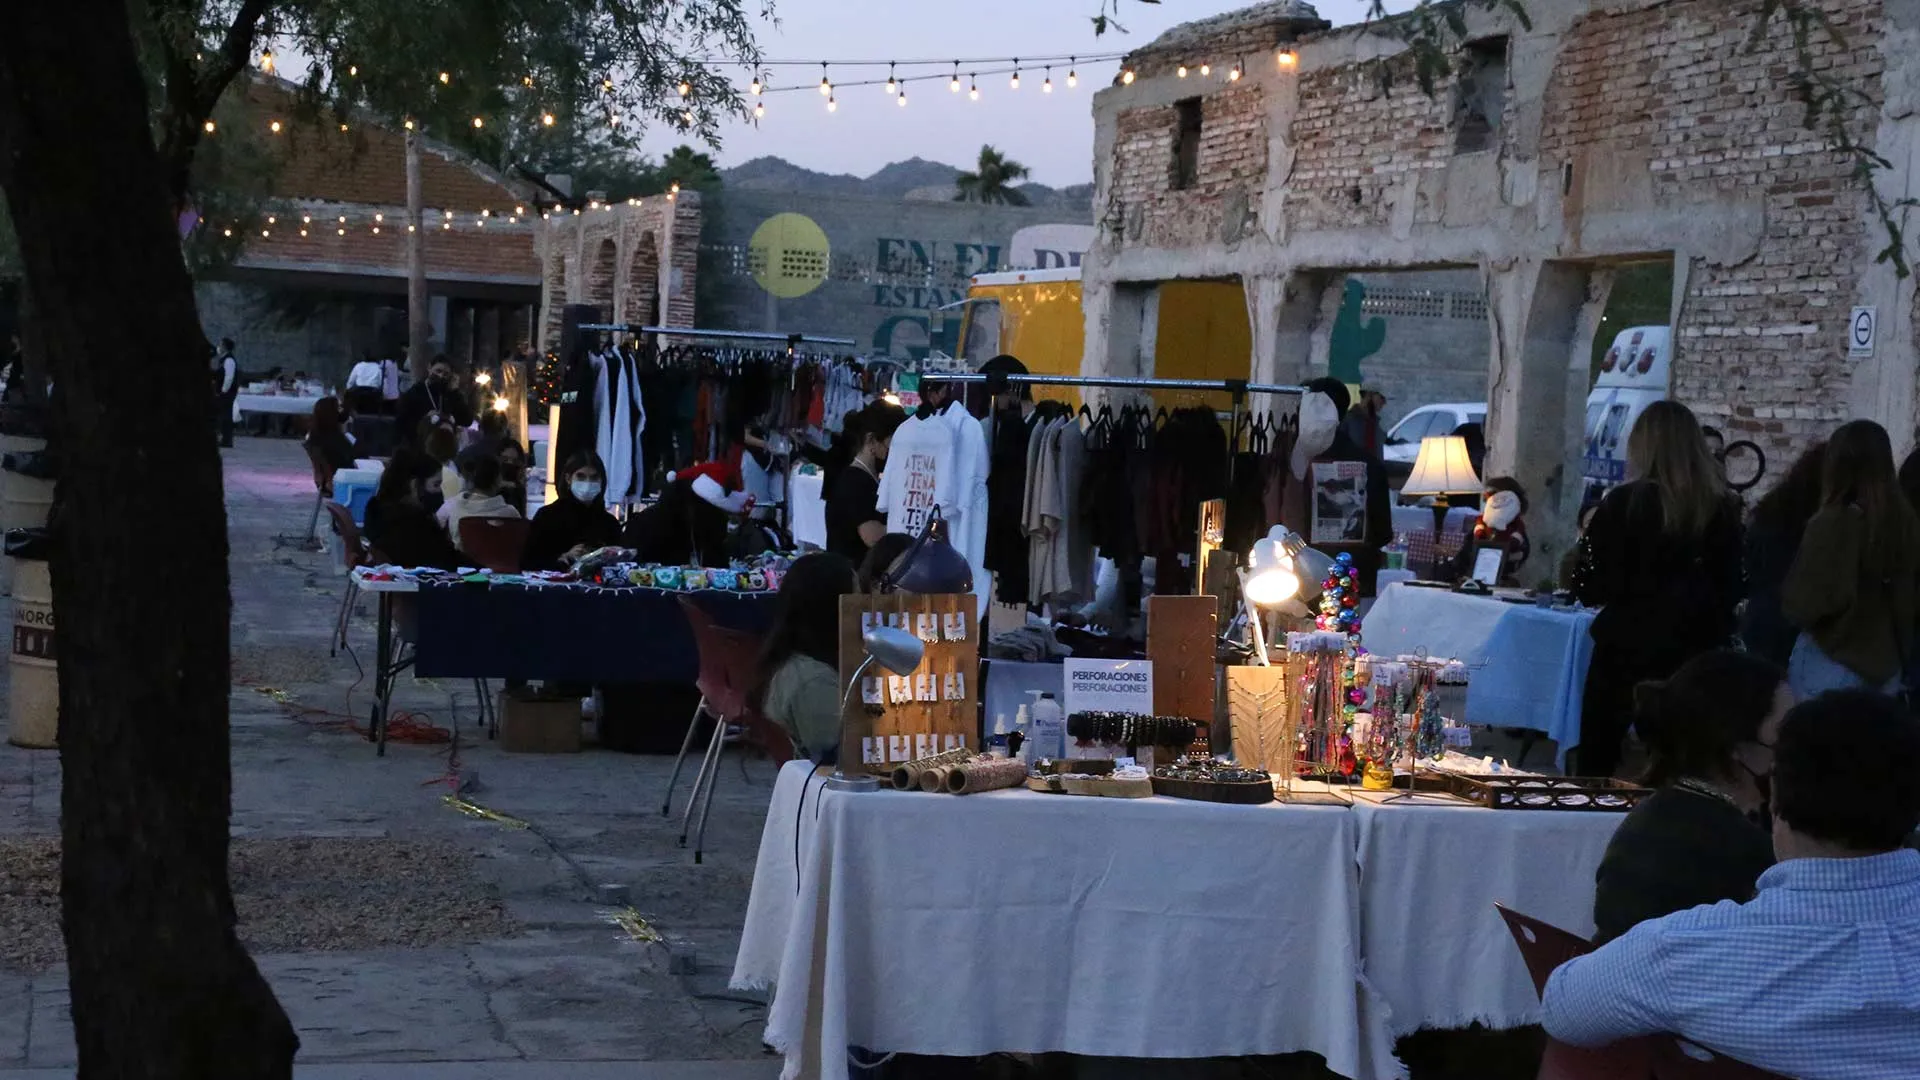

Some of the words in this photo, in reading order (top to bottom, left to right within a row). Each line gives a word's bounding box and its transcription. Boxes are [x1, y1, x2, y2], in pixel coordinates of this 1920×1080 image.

[876, 238, 937, 275] EN
[1072, 671, 1148, 682] PERFORACIONES
[1072, 682, 1148, 693] PERFORACIONES
